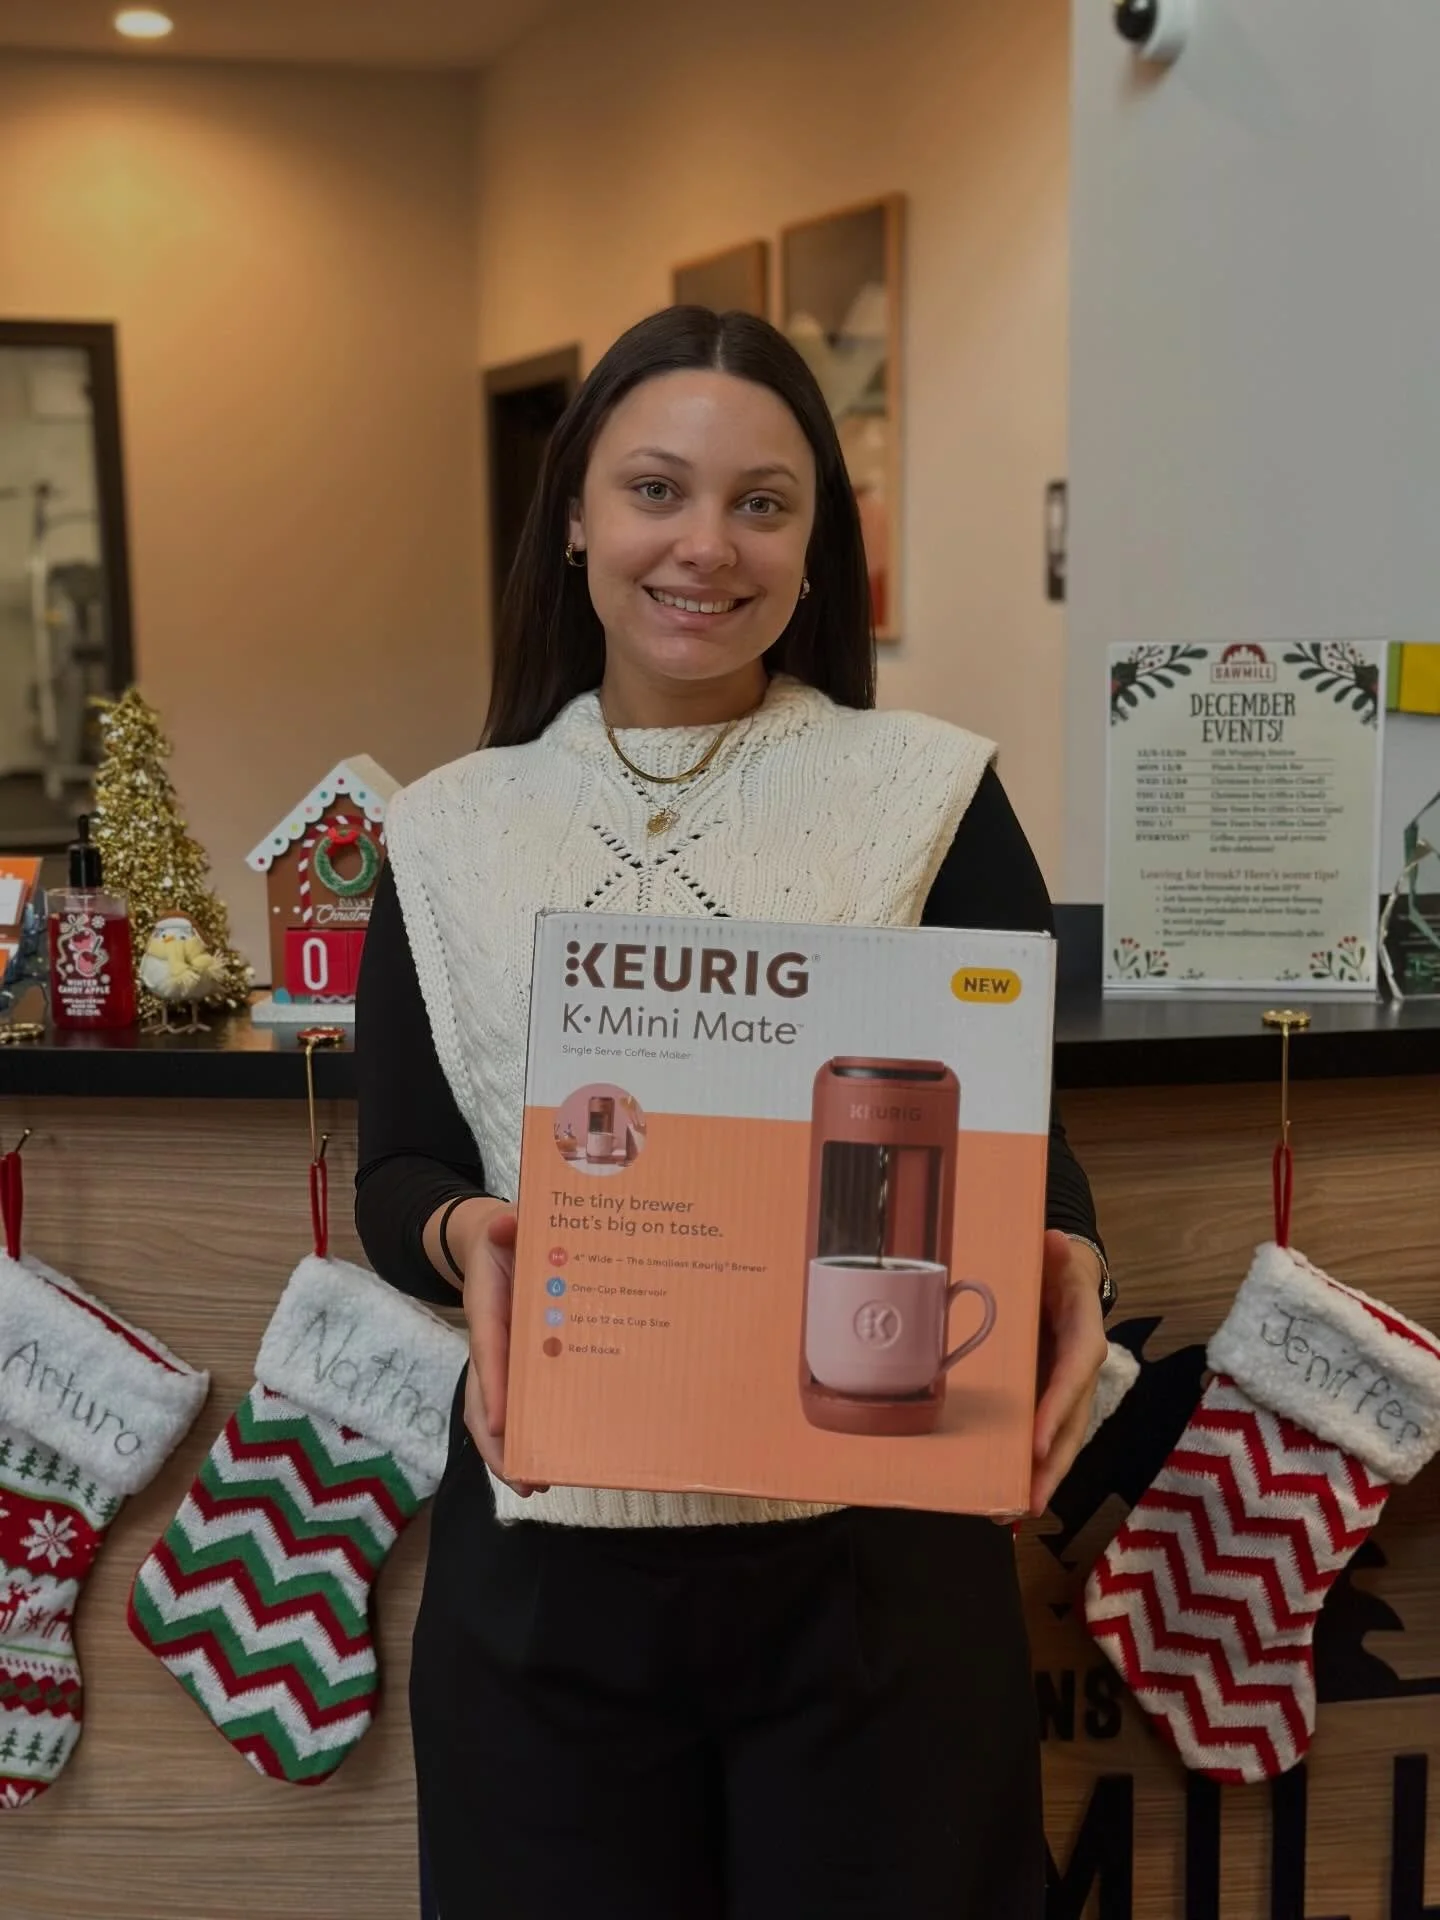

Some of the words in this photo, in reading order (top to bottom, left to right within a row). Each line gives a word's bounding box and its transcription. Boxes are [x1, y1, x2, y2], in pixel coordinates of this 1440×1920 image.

[1215, 664, 1272, 680] SAWMILL
[1190, 692, 1296, 717] DECEMBER
[1202, 719, 1284, 744] EVENTS!
[303, 937, 328, 990] 0
[565, 940, 810, 998] KEURIG
[84, 985, 111, 995] APPLE
[963, 977, 1010, 994] NEW
[693, 1010, 798, 1045] Mate
[562, 1044, 592, 1057] Single
[594, 1046, 623, 1057] Serve
[624, 1047, 657, 1059] Coffee
[659, 1049, 691, 1060] Maker
[551, 1191, 585, 1208] The
[590, 1193, 625, 1213] tiny
[630, 1195, 695, 1213] brewer
[549, 1213, 603, 1231] that's
[607, 1216, 637, 1237] big
[642, 1221, 665, 1234] on
[670, 1221, 724, 1238] taste.
[588, 1255, 613, 1265] Wide
[626, 1256, 644, 1267] The
[647, 1258, 689, 1269] Smallest
[731, 1262, 768, 1273] Brewer
[619, 1286, 668, 1297] Reservoir
[570, 1314, 584, 1324] Up
[586, 1315, 598, 1324] to
[599, 1315, 611, 1325] 12
[612, 1318, 625, 1326] oz
[627, 1317, 647, 1329] Cup
[650, 1318, 671, 1329] Size
[568, 1343, 589, 1354] Red
[1260, 1302, 1422, 1445] Jeniffer
[2, 1338, 141, 1456] Arturo
